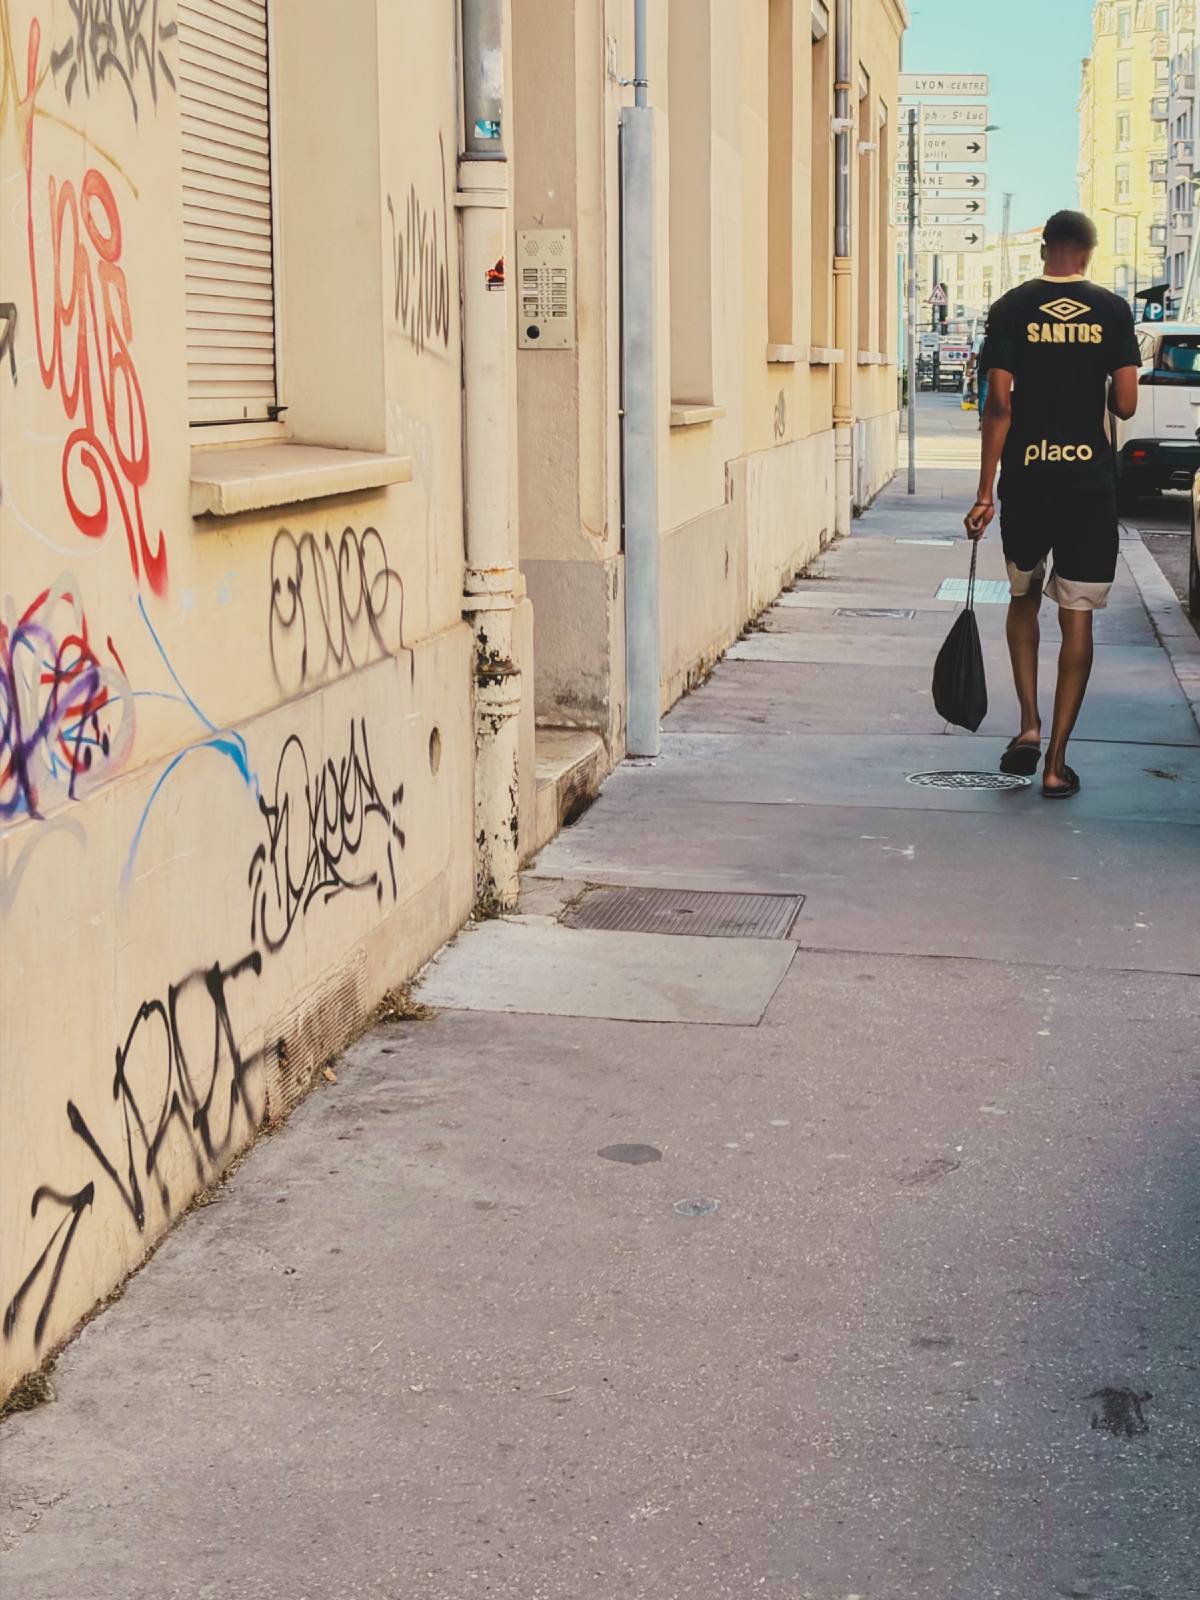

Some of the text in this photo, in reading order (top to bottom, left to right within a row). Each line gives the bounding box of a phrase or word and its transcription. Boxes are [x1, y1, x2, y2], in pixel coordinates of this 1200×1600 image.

[915, 80, 985, 90] LYON CENTRE
[966, 111, 984, 120] Luc
[1027, 322, 1103, 344] SANTOS
[1024, 439, 1093, 466] placo
